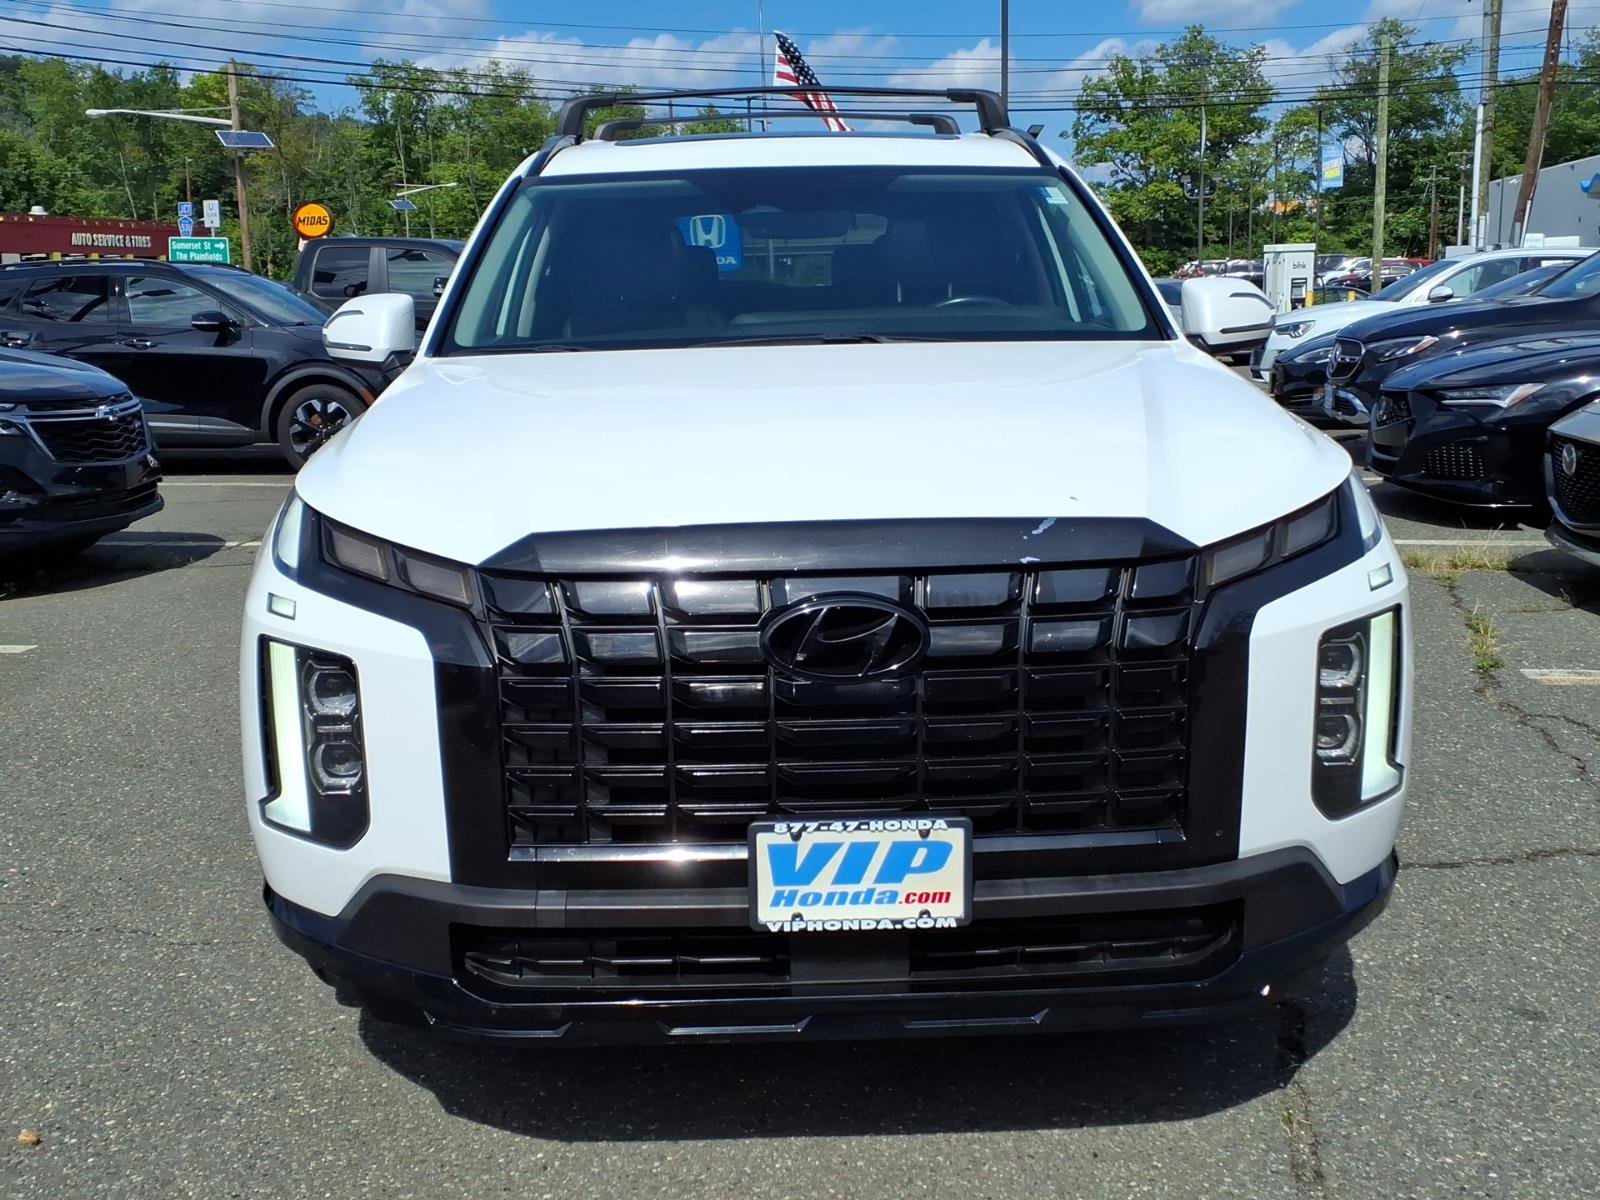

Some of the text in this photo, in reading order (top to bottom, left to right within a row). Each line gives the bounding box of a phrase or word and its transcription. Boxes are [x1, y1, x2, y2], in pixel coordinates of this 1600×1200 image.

[296, 215, 328, 227] MIDAS
[71, 232, 152, 248] AUTO SERVICE & TIRES
[171, 240, 211, 250] Somerset St
[176, 251, 223, 261] The Plainfields
[774, 819, 948, 834] 877-47-HONDA
[767, 840, 954, 887] VIP
[769, 887, 951, 908] Honda.com
[766, 917, 957, 933] VIPHONDA.COM
